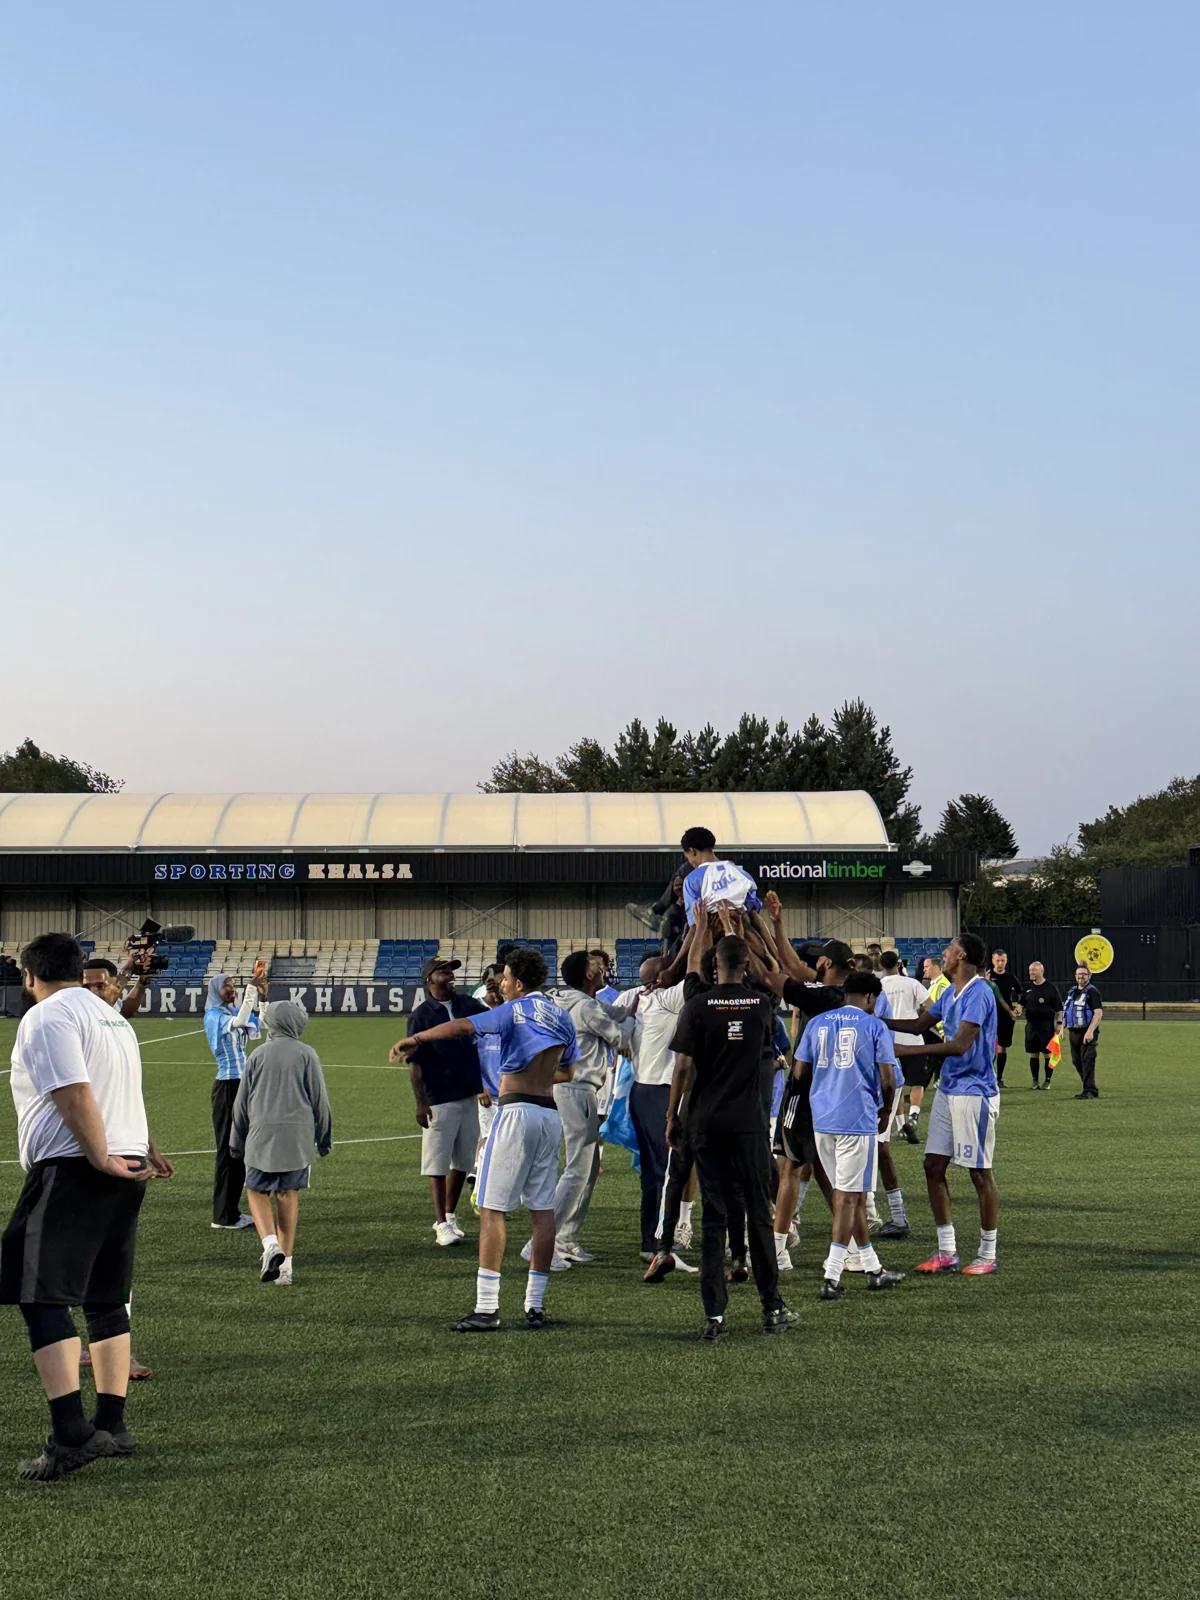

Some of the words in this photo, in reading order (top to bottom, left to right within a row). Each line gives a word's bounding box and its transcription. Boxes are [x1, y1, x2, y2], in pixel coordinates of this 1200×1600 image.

[154, 864, 295, 879] SPORTING
[308, 864, 413, 879] KHALSA
[289, 987, 426, 1012] KHALSA
[707, 998, 760, 1006] MANAGEMENT
[825, 1013, 859, 1021] SOMALIA
[816, 1026, 858, 1069] 19
